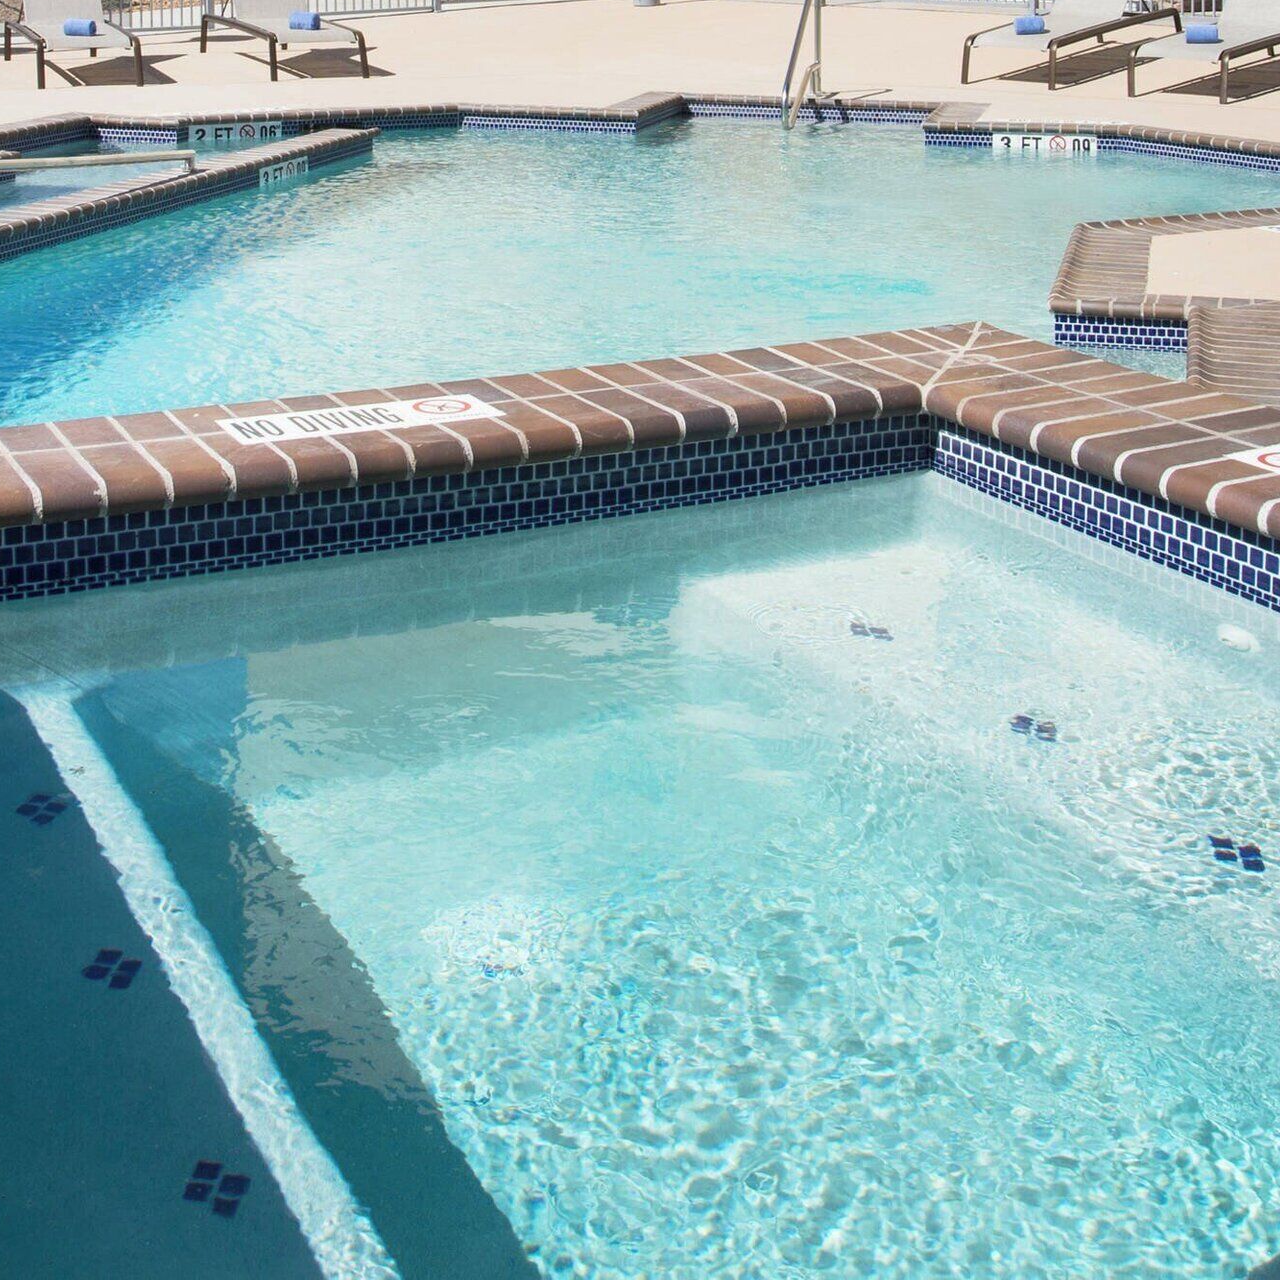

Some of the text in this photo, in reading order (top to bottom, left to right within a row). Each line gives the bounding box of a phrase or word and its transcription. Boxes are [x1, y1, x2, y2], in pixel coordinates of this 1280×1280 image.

[215, 127, 233, 139] FT
[1022, 137, 1042, 150] FT
[231, 407, 404, 439] NO DIVING
